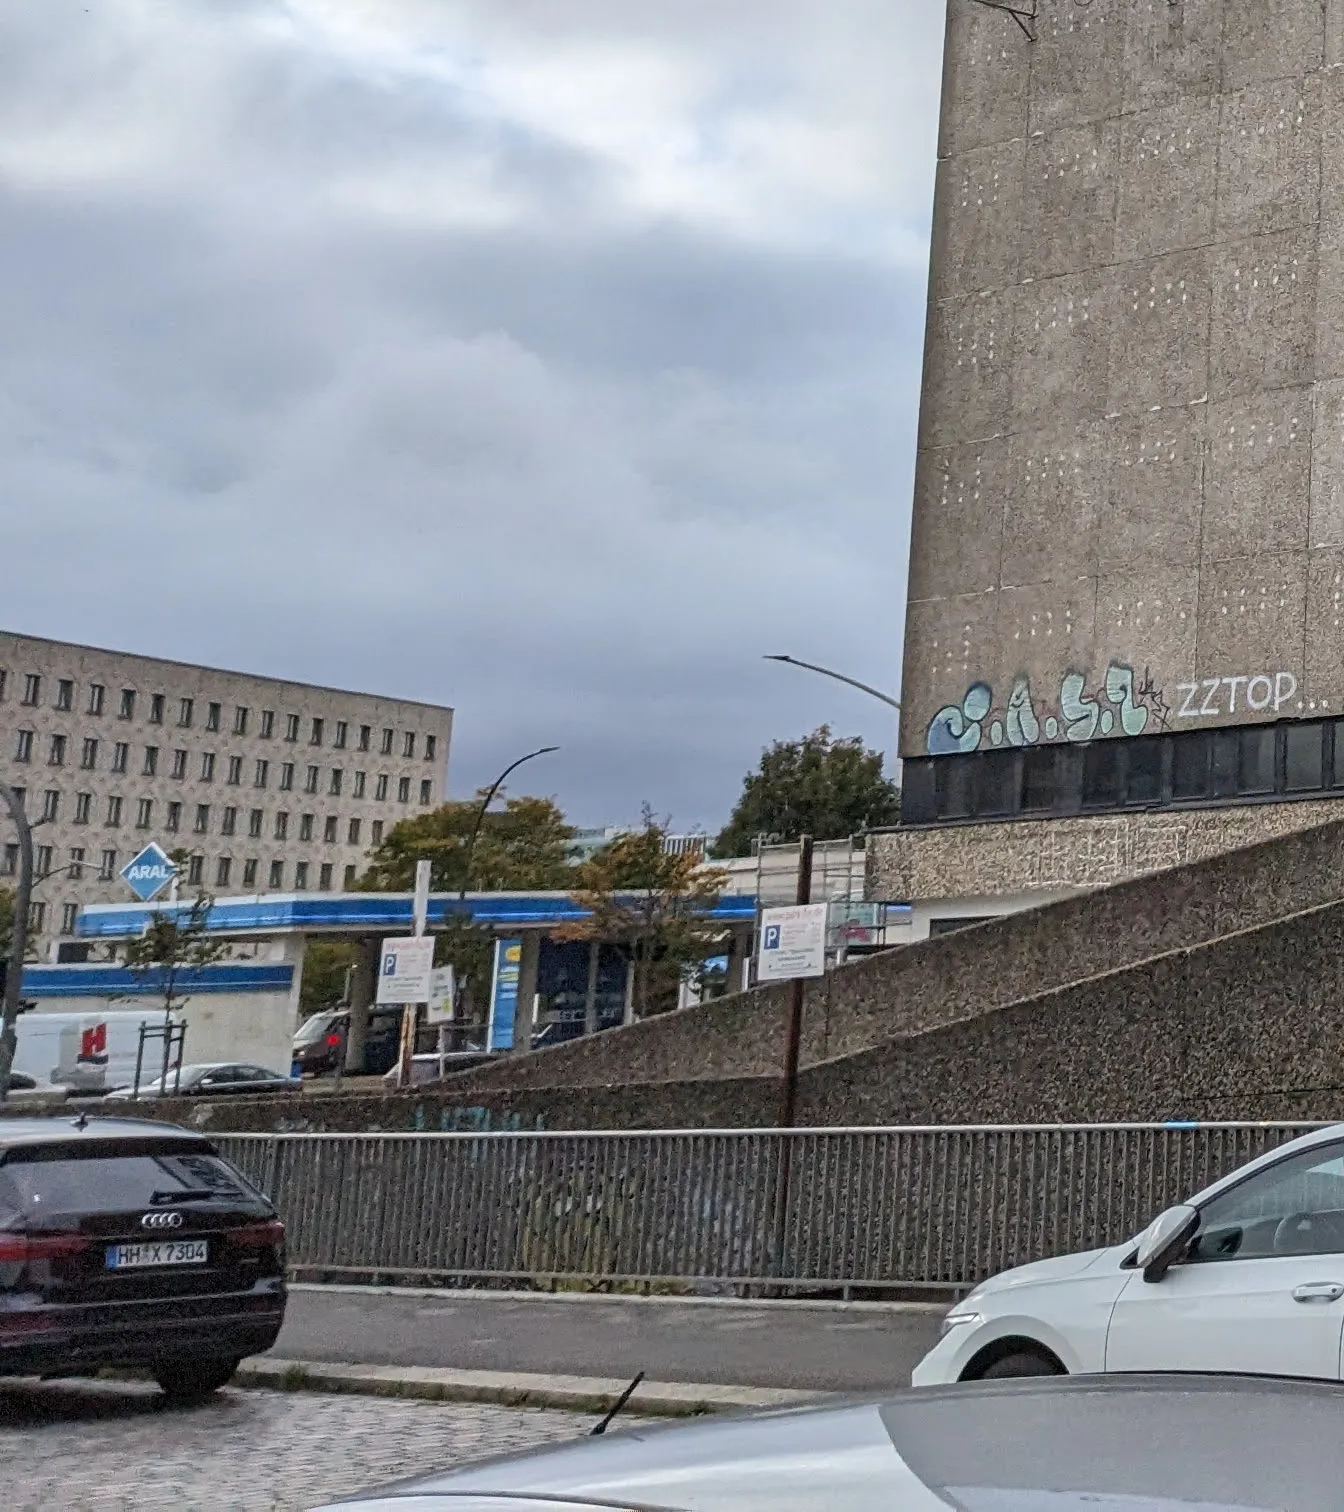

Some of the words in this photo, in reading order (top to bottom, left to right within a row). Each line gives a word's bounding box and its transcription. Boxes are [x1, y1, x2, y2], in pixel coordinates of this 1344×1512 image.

[127, 864, 169, 880] ARAL
[118, 1246, 141, 1265] HH
[167, 1243, 204, 1261] 7304
